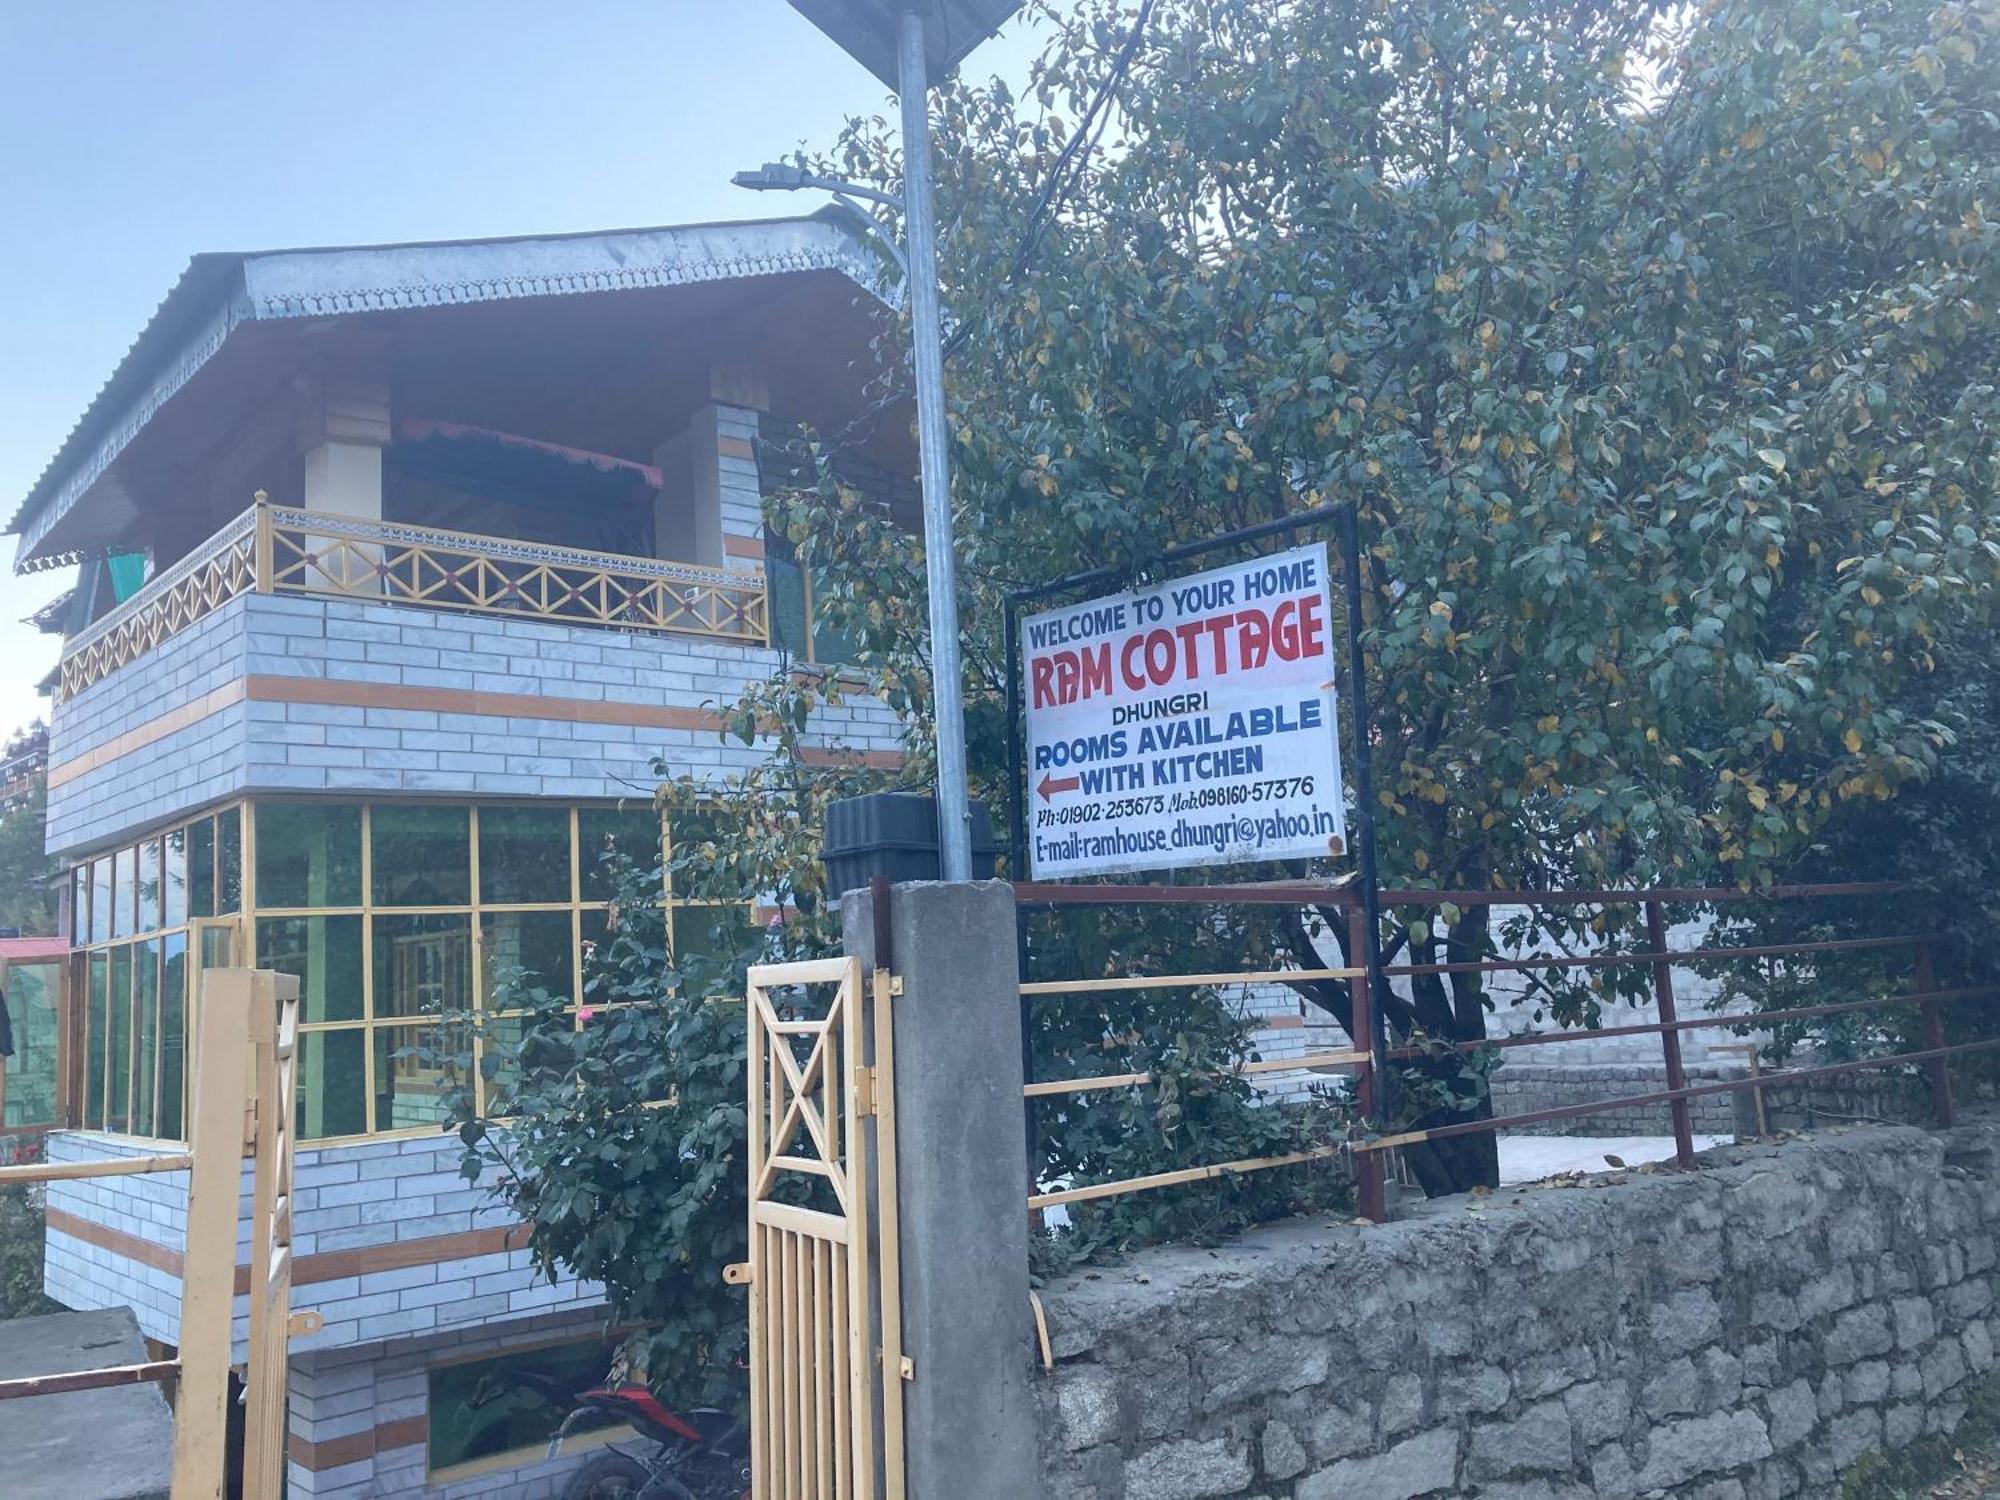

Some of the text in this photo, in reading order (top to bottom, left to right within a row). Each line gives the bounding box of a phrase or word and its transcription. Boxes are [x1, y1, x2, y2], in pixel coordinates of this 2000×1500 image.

[1029, 558, 1317, 649] WELCOME TO YOUR HOME
[1031, 594, 1324, 710] RAM COTTAGE
[1035, 699, 1322, 769] ROOMS AVAILABLE
[1112, 690, 1208, 725] DHUNGRI
[1080, 744, 1264, 795] WITH KITCHEN
